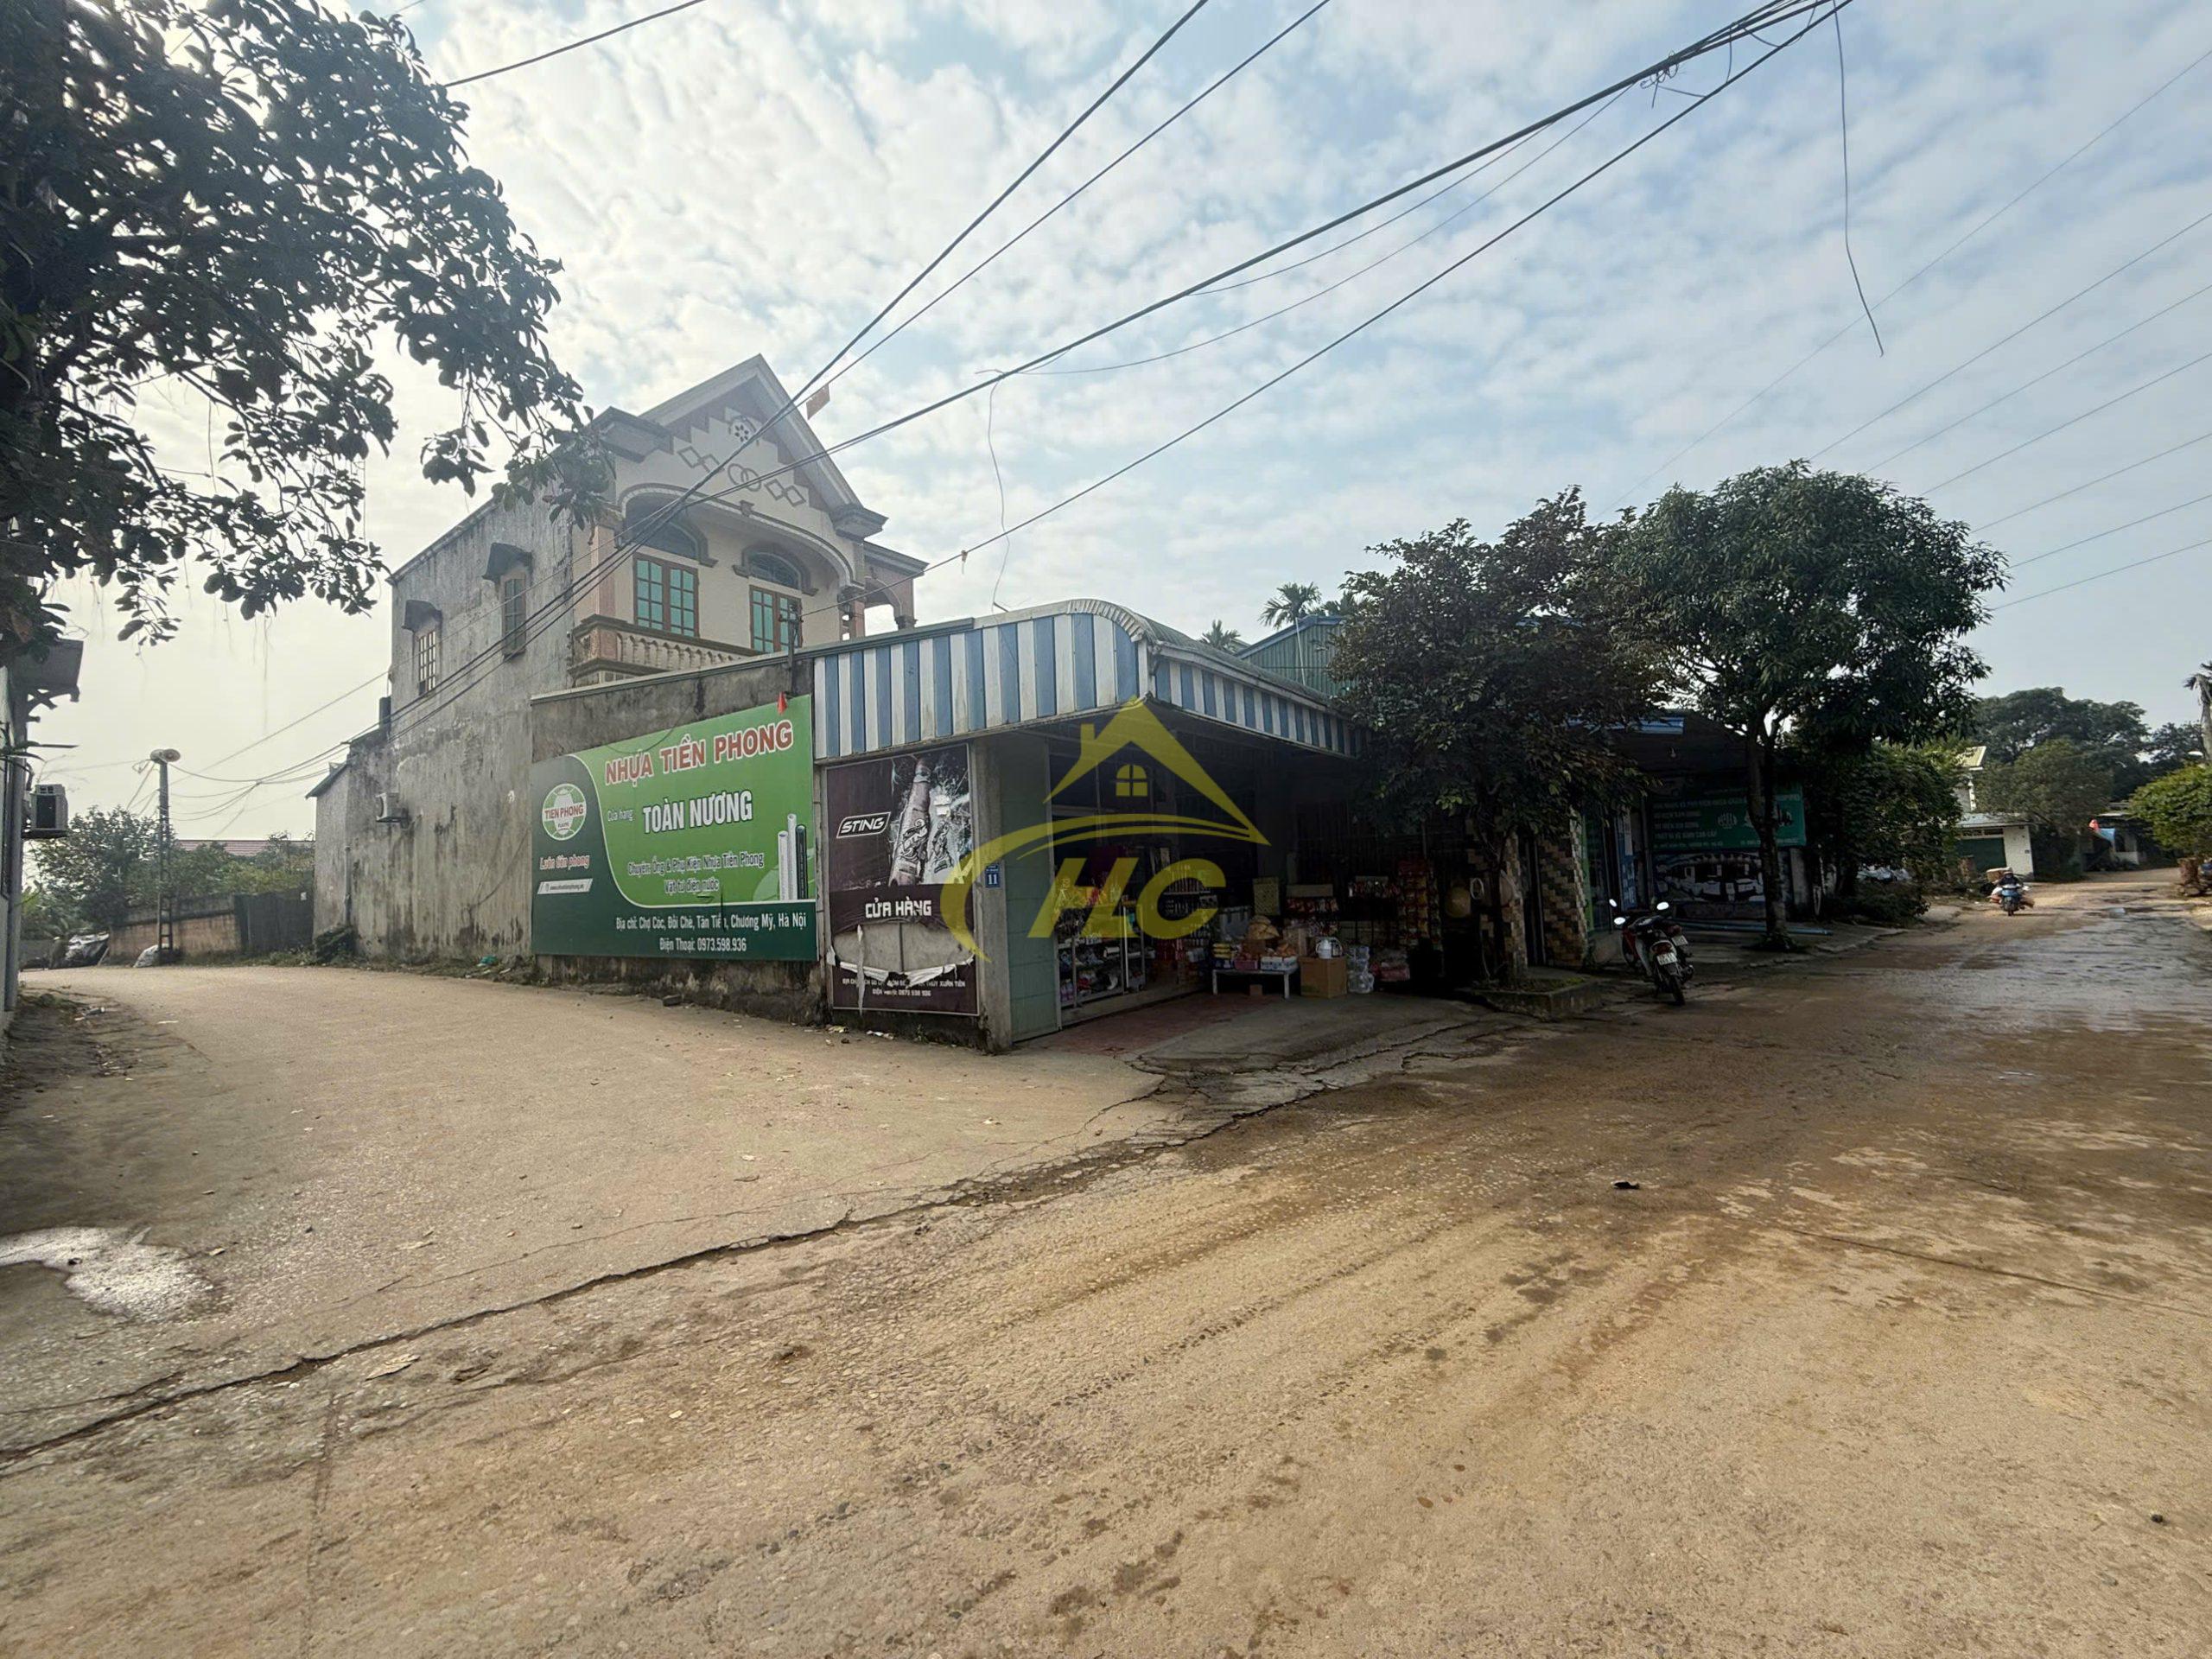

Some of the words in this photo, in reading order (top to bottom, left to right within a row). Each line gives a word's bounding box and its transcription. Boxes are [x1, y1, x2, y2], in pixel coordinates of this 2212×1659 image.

[606, 749, 654, 787] NHỰA
[660, 734, 706, 774] TIỀN
[714, 719, 793, 763] PHONG
[560, 804, 584, 819] PHONG
[643, 797, 685, 834] TOÀN
[690, 789, 753, 828] NƯƠNG
[840, 816, 886, 835] STING
[702, 855, 721, 872] Nhựa
[740, 850, 765, 869] Phong
[988, 874, 998, 885] 11
[865, 898, 893, 918] CỬA
[895, 896, 932, 917] HÀNG
[730, 914, 760, 931] Chương
[761, 912, 776, 931] Mỹ,
[778, 912, 790, 928] Hà
[792, 912, 807, 931] Nội
[696, 937, 747, 952] 0973.598.936
